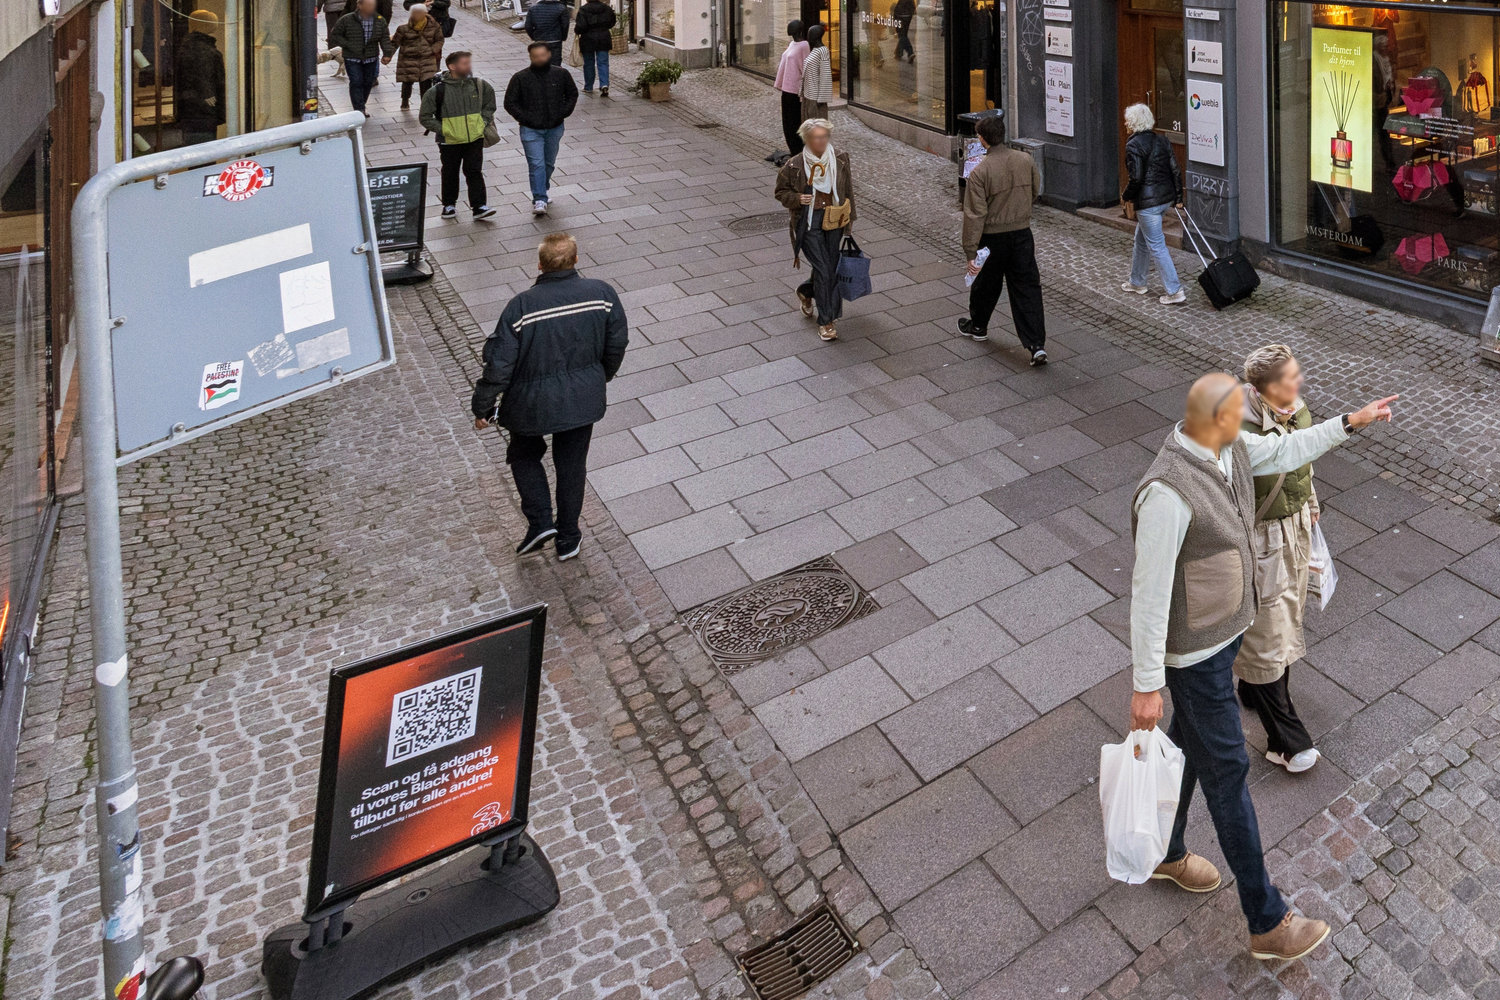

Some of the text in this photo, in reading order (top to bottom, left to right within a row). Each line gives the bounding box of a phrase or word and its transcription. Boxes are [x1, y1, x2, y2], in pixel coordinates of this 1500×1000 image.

[876, 14, 902, 29] Studios
[1323, 43, 1353, 55] Parfumer
[1340, 56, 1355, 68] hjem
[1058, 80, 1072, 90] Plain
[1201, 99, 1219, 107] webia
[1172, 121, 1181, 131] 31
[369, 175, 409, 189] EJSER
[1304, 225, 1363, 247] AMSTERDAM
[1437, 256, 1468, 272] PARIS
[216, 363, 232, 371] FREE
[205, 368, 240, 382] PALESTINE
[361, 745, 493, 801] Scan og få adgang
[350, 755, 499, 818] til vores Black Weeks
[353, 768, 493, 830] tilbud før alle andre!
